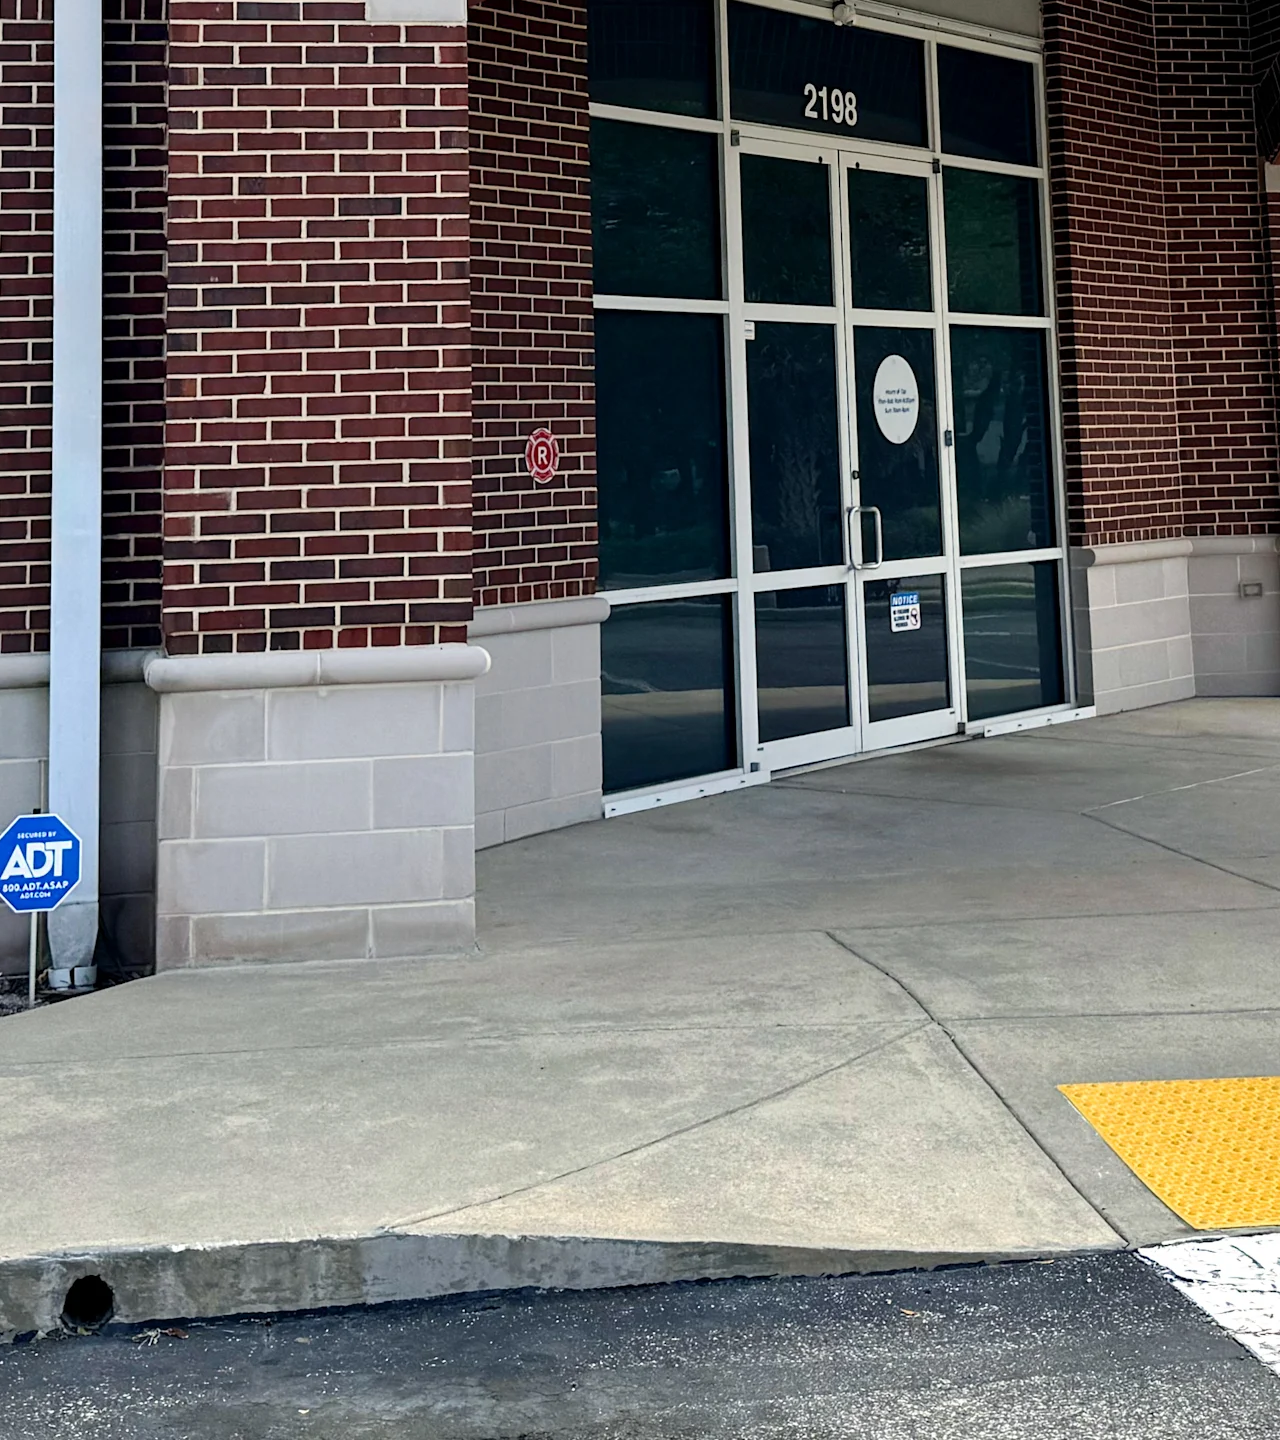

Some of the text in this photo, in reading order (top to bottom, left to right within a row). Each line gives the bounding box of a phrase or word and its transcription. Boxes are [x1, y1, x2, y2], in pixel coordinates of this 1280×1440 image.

[804, 83, 858, 127] 2198
[537, 446, 549, 465] R
[892, 595, 918, 606] NOTICE
[17, 831, 47, 839] SECURED
[0, 841, 73, 880] ADT
[2, 880, 69, 893] 800.ADT.ASAP
[19, 891, 52, 899] ADT.COM
